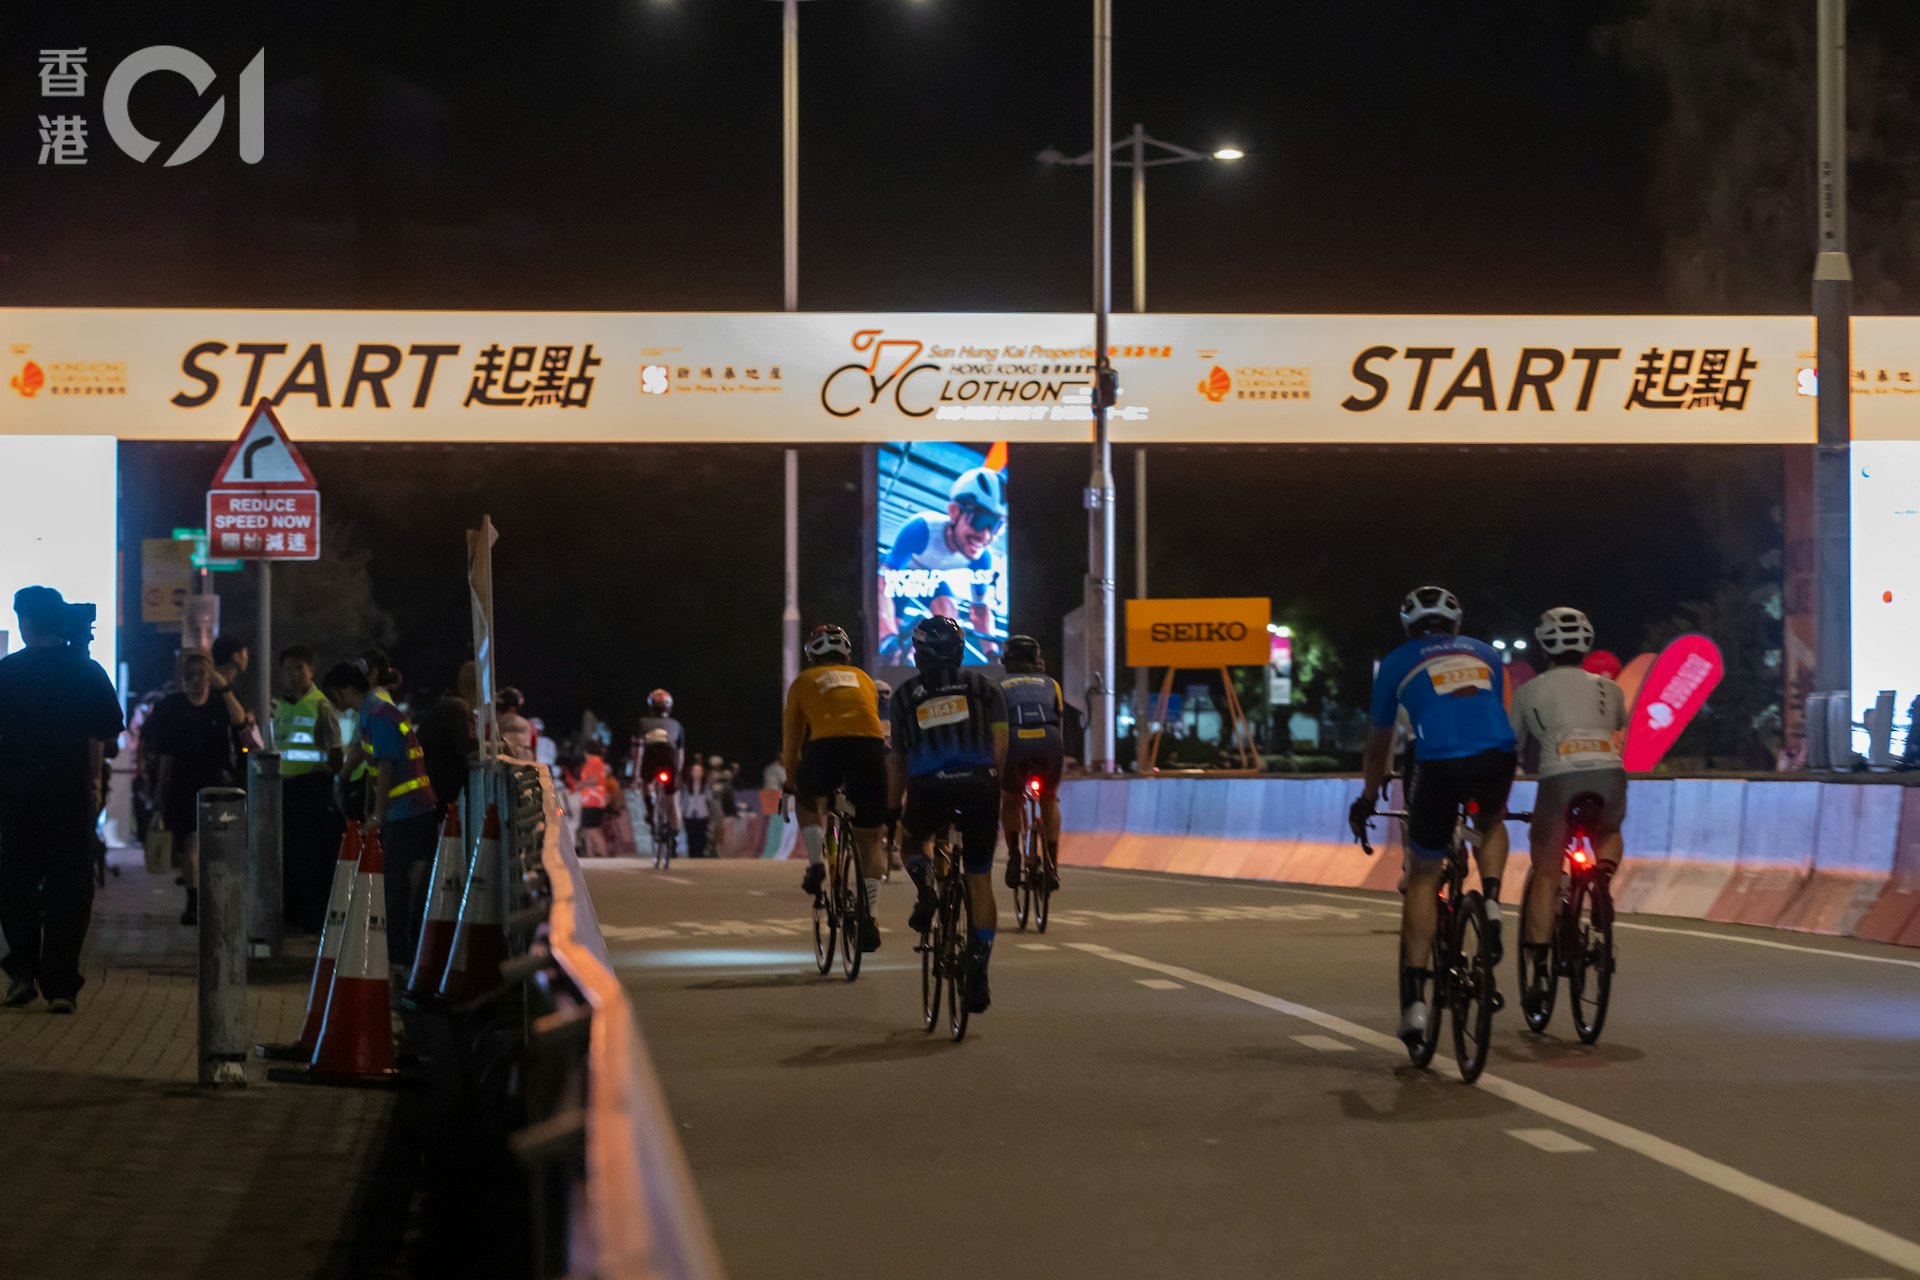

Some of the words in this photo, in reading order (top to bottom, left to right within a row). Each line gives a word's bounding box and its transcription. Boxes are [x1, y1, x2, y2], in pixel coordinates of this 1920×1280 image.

[928, 345, 956, 358] Sun
[958, 345, 997, 361] Hung
[1001, 345, 1027, 358] Kai
[171, 342, 460, 409] START
[463, 344, 602, 409] 起點
[951, 364, 992, 374] HONG
[997, 364, 1038, 374] KONG
[1341, 345, 1621, 411] START
[1625, 347, 1759, 411] 起點
[229, 498, 296, 512] REDUCE
[214, 515, 268, 528] SPEED
[272, 515, 311, 528] NOW
[1151, 621, 1248, 642] SEIKO
